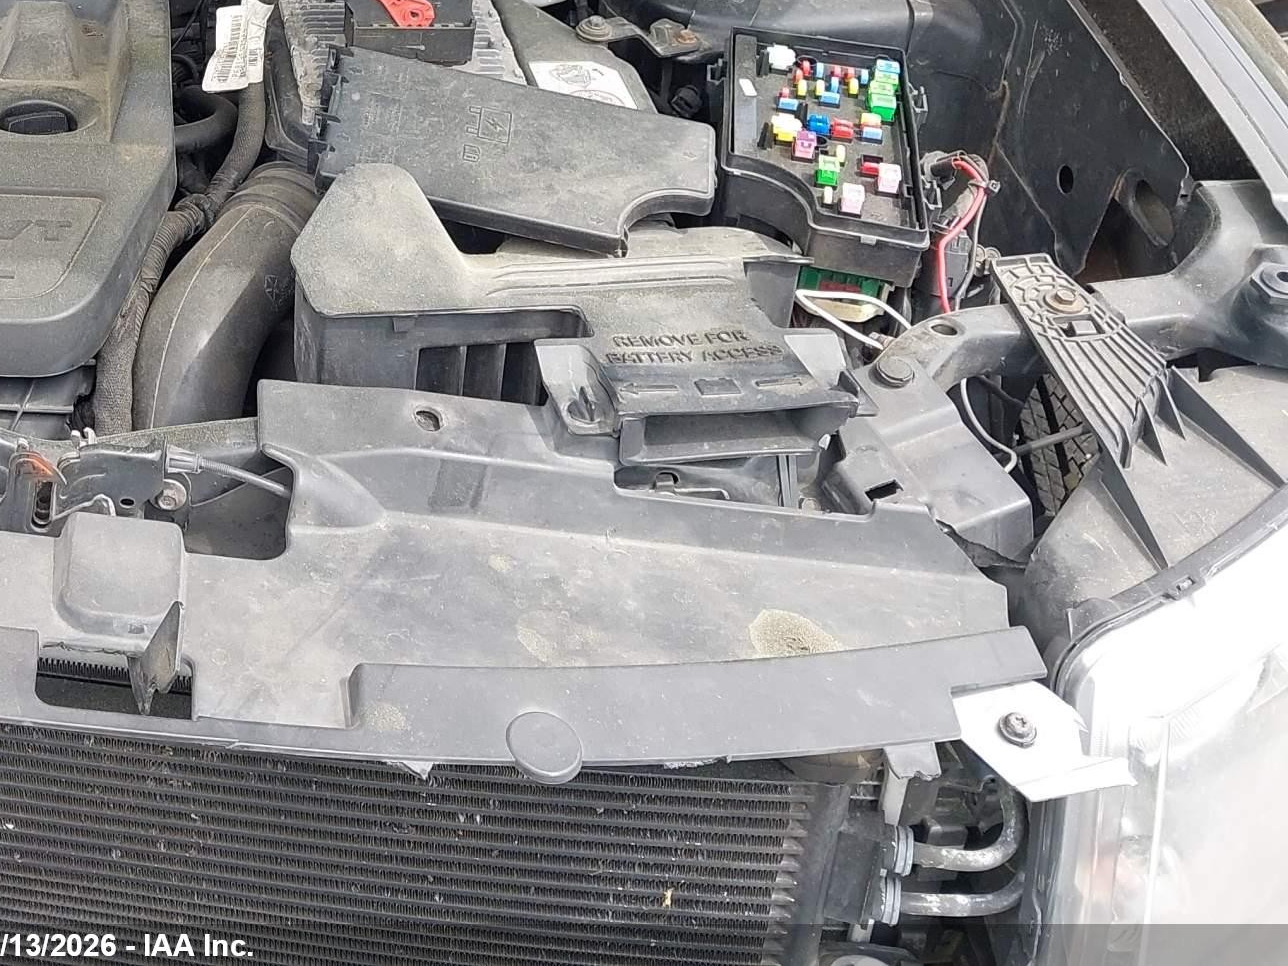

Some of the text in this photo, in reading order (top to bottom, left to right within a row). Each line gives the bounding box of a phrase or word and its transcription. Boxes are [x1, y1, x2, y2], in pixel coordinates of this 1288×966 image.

[612, 328, 750, 348] REMOVE FOR
[605, 343, 784, 365] BATTERY ACCESS
